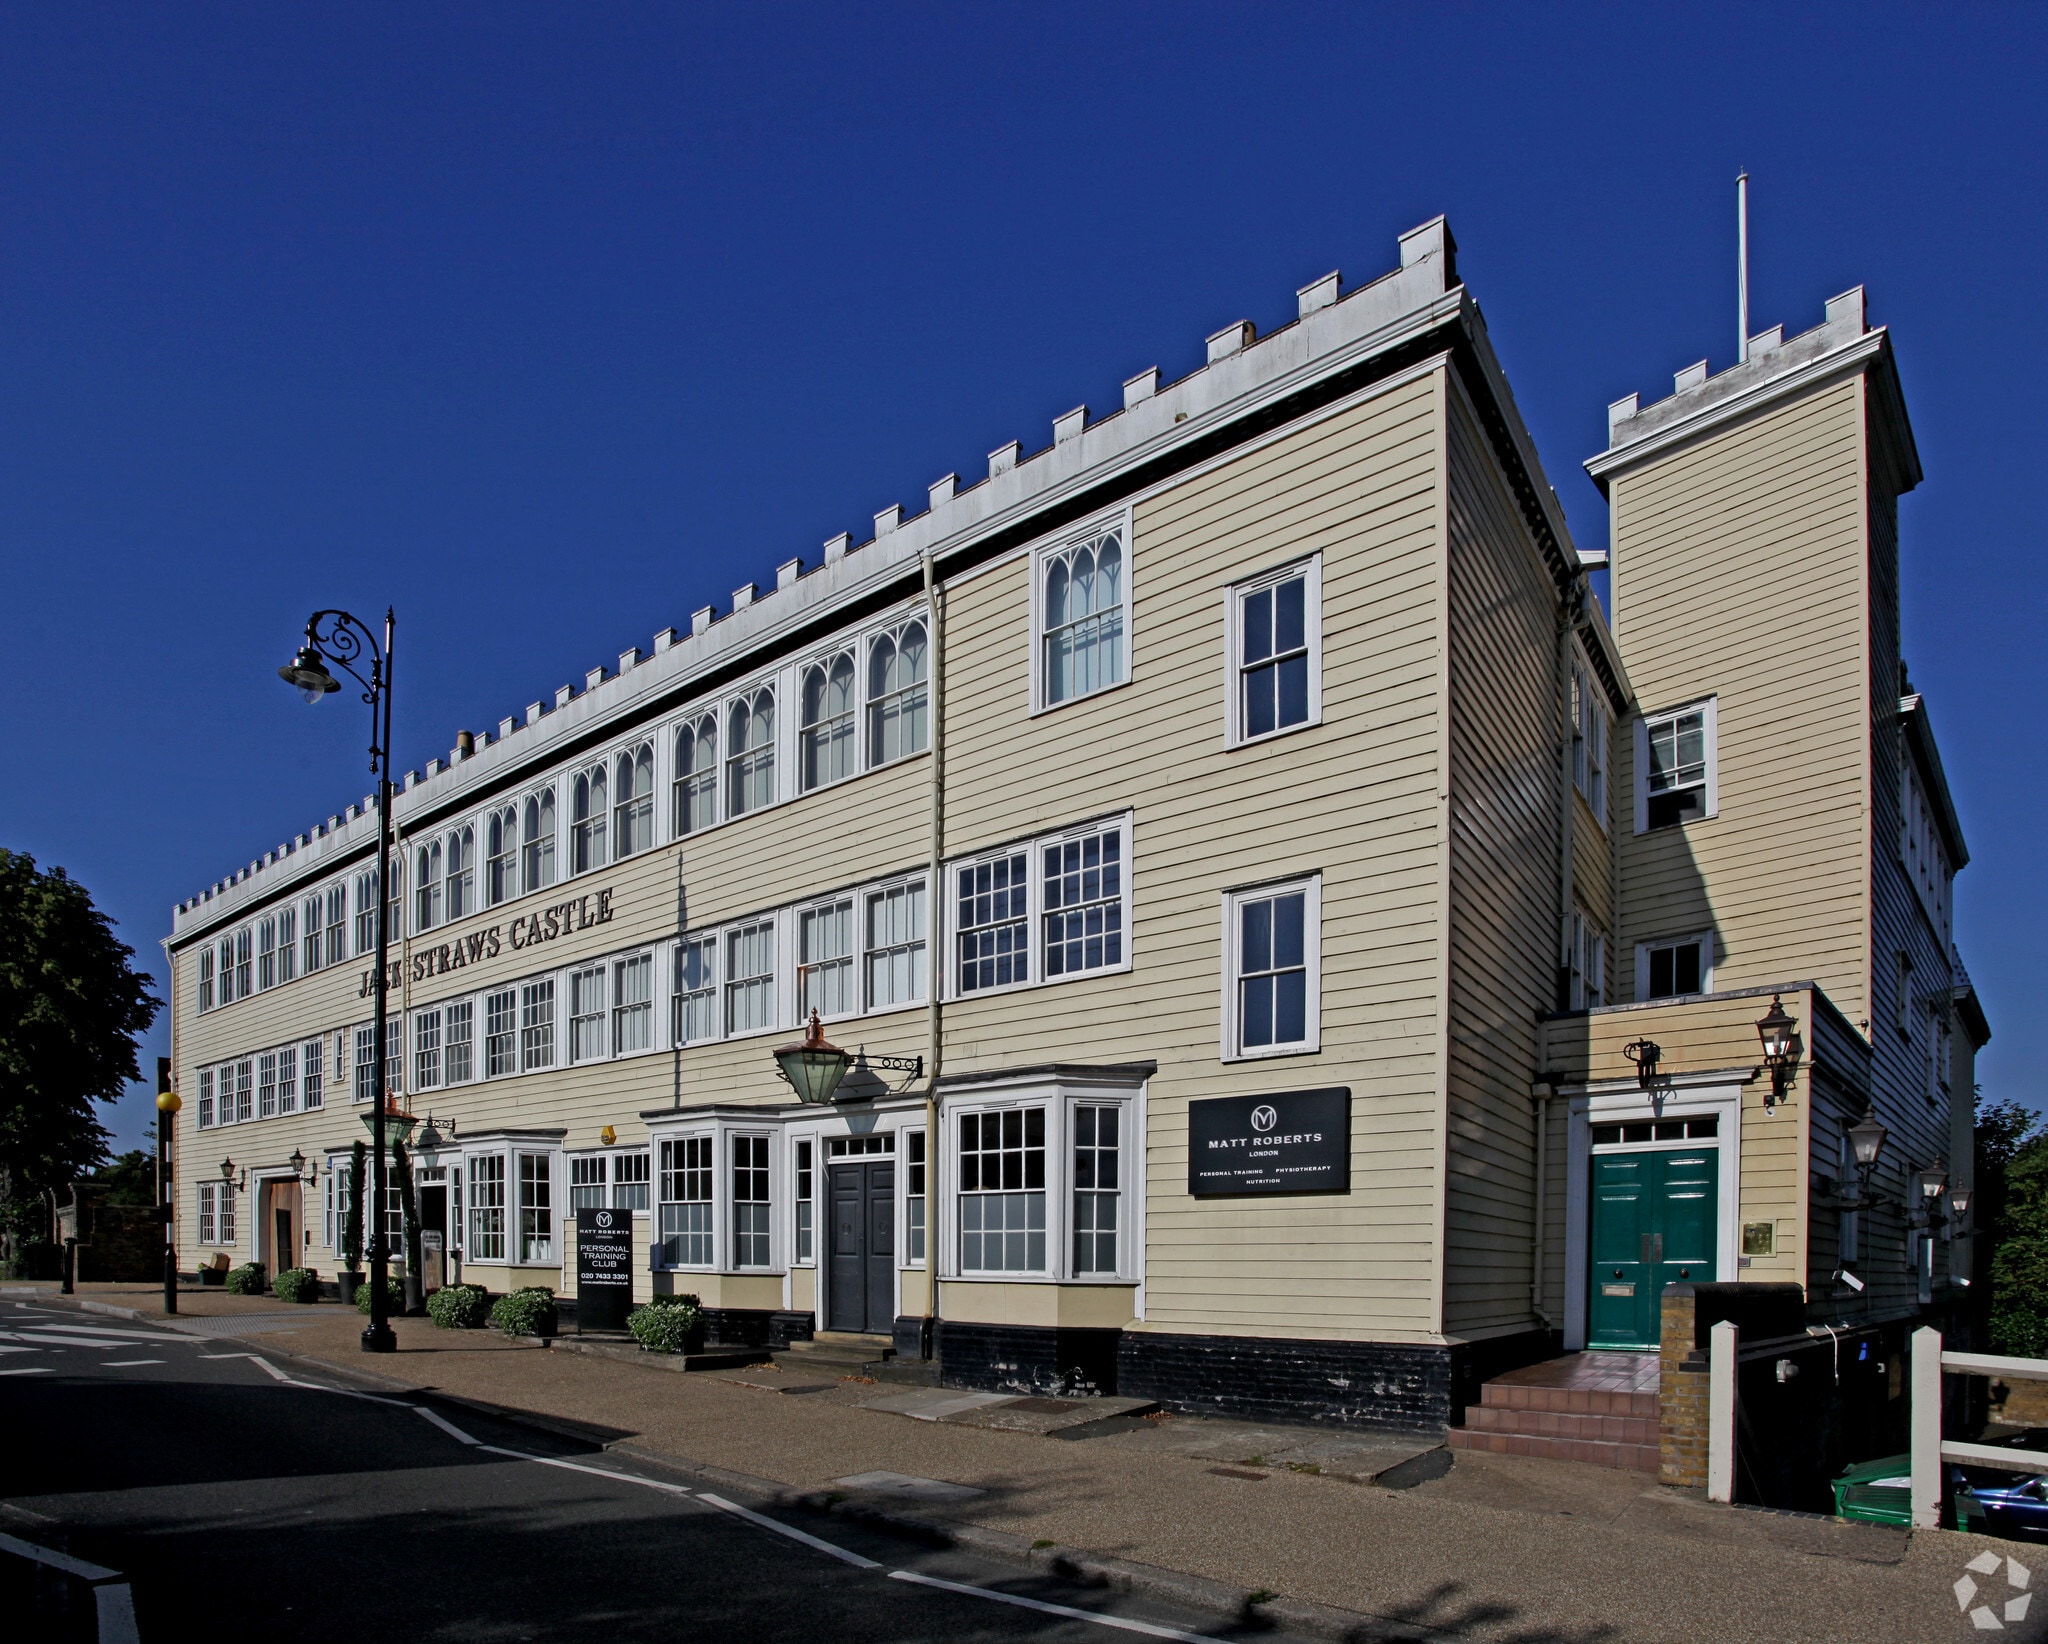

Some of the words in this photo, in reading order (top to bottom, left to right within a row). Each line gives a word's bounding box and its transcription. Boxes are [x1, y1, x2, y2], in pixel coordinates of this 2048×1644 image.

[413, 925, 500, 982] STRAWS
[508, 887, 614, 950] CASTLE
[1208, 1138, 1248, 1149] MATT
[1253, 1133, 1323, 1146] ROBERTS
[1275, 1165, 1331, 1173] PHYSIOTHERAPY
[580, 1244, 630, 1253] PERSONAL
[583, 1252, 627, 1260] TRAINING
[591, 1260, 617, 1268] CLUB
